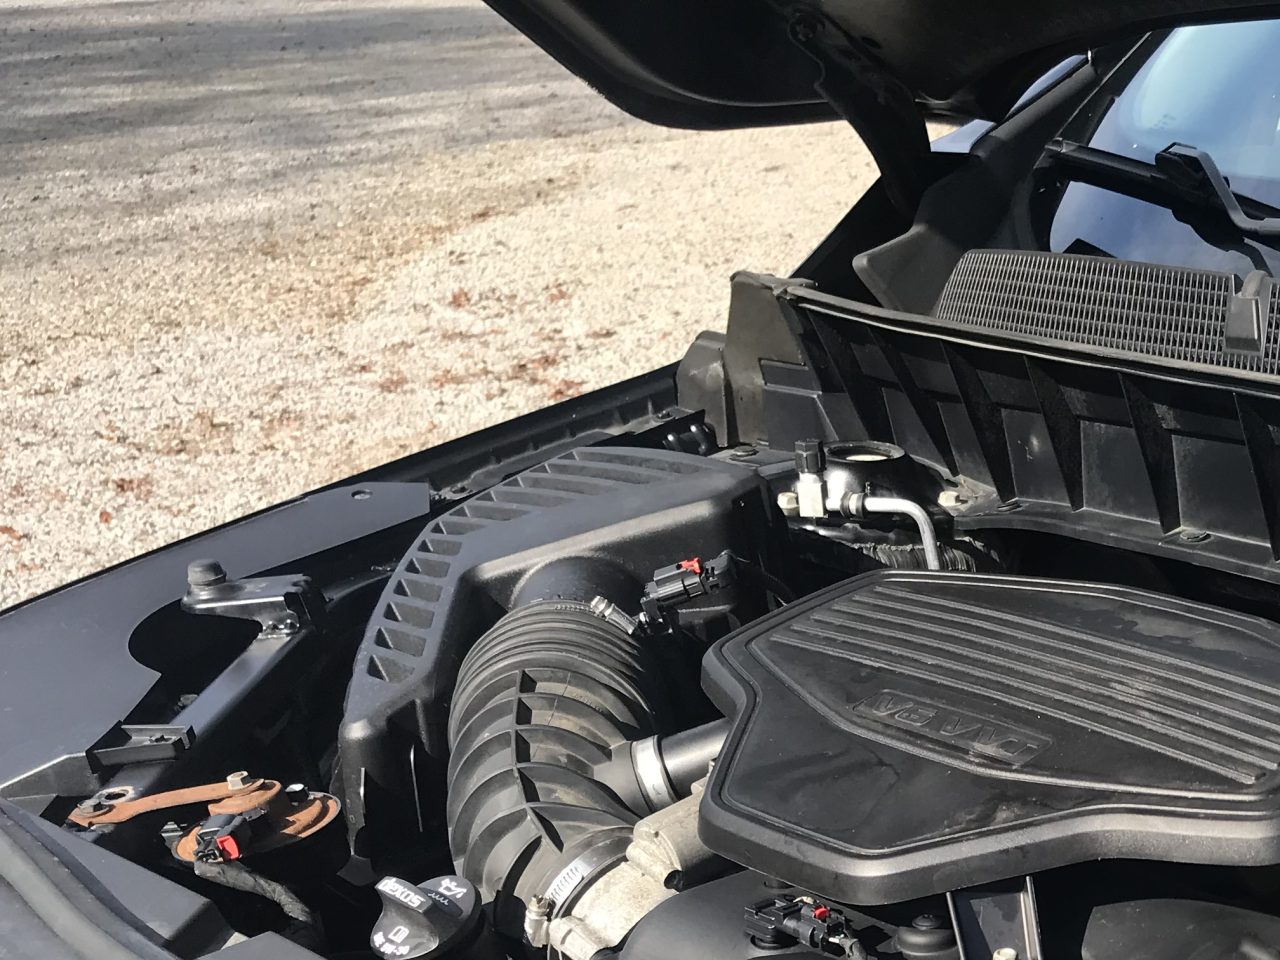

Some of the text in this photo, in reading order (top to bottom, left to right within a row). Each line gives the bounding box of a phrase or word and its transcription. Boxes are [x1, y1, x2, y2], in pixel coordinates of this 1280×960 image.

[872, 695, 1040, 757] V6 VVT
[377, 878, 426, 908] dexos
